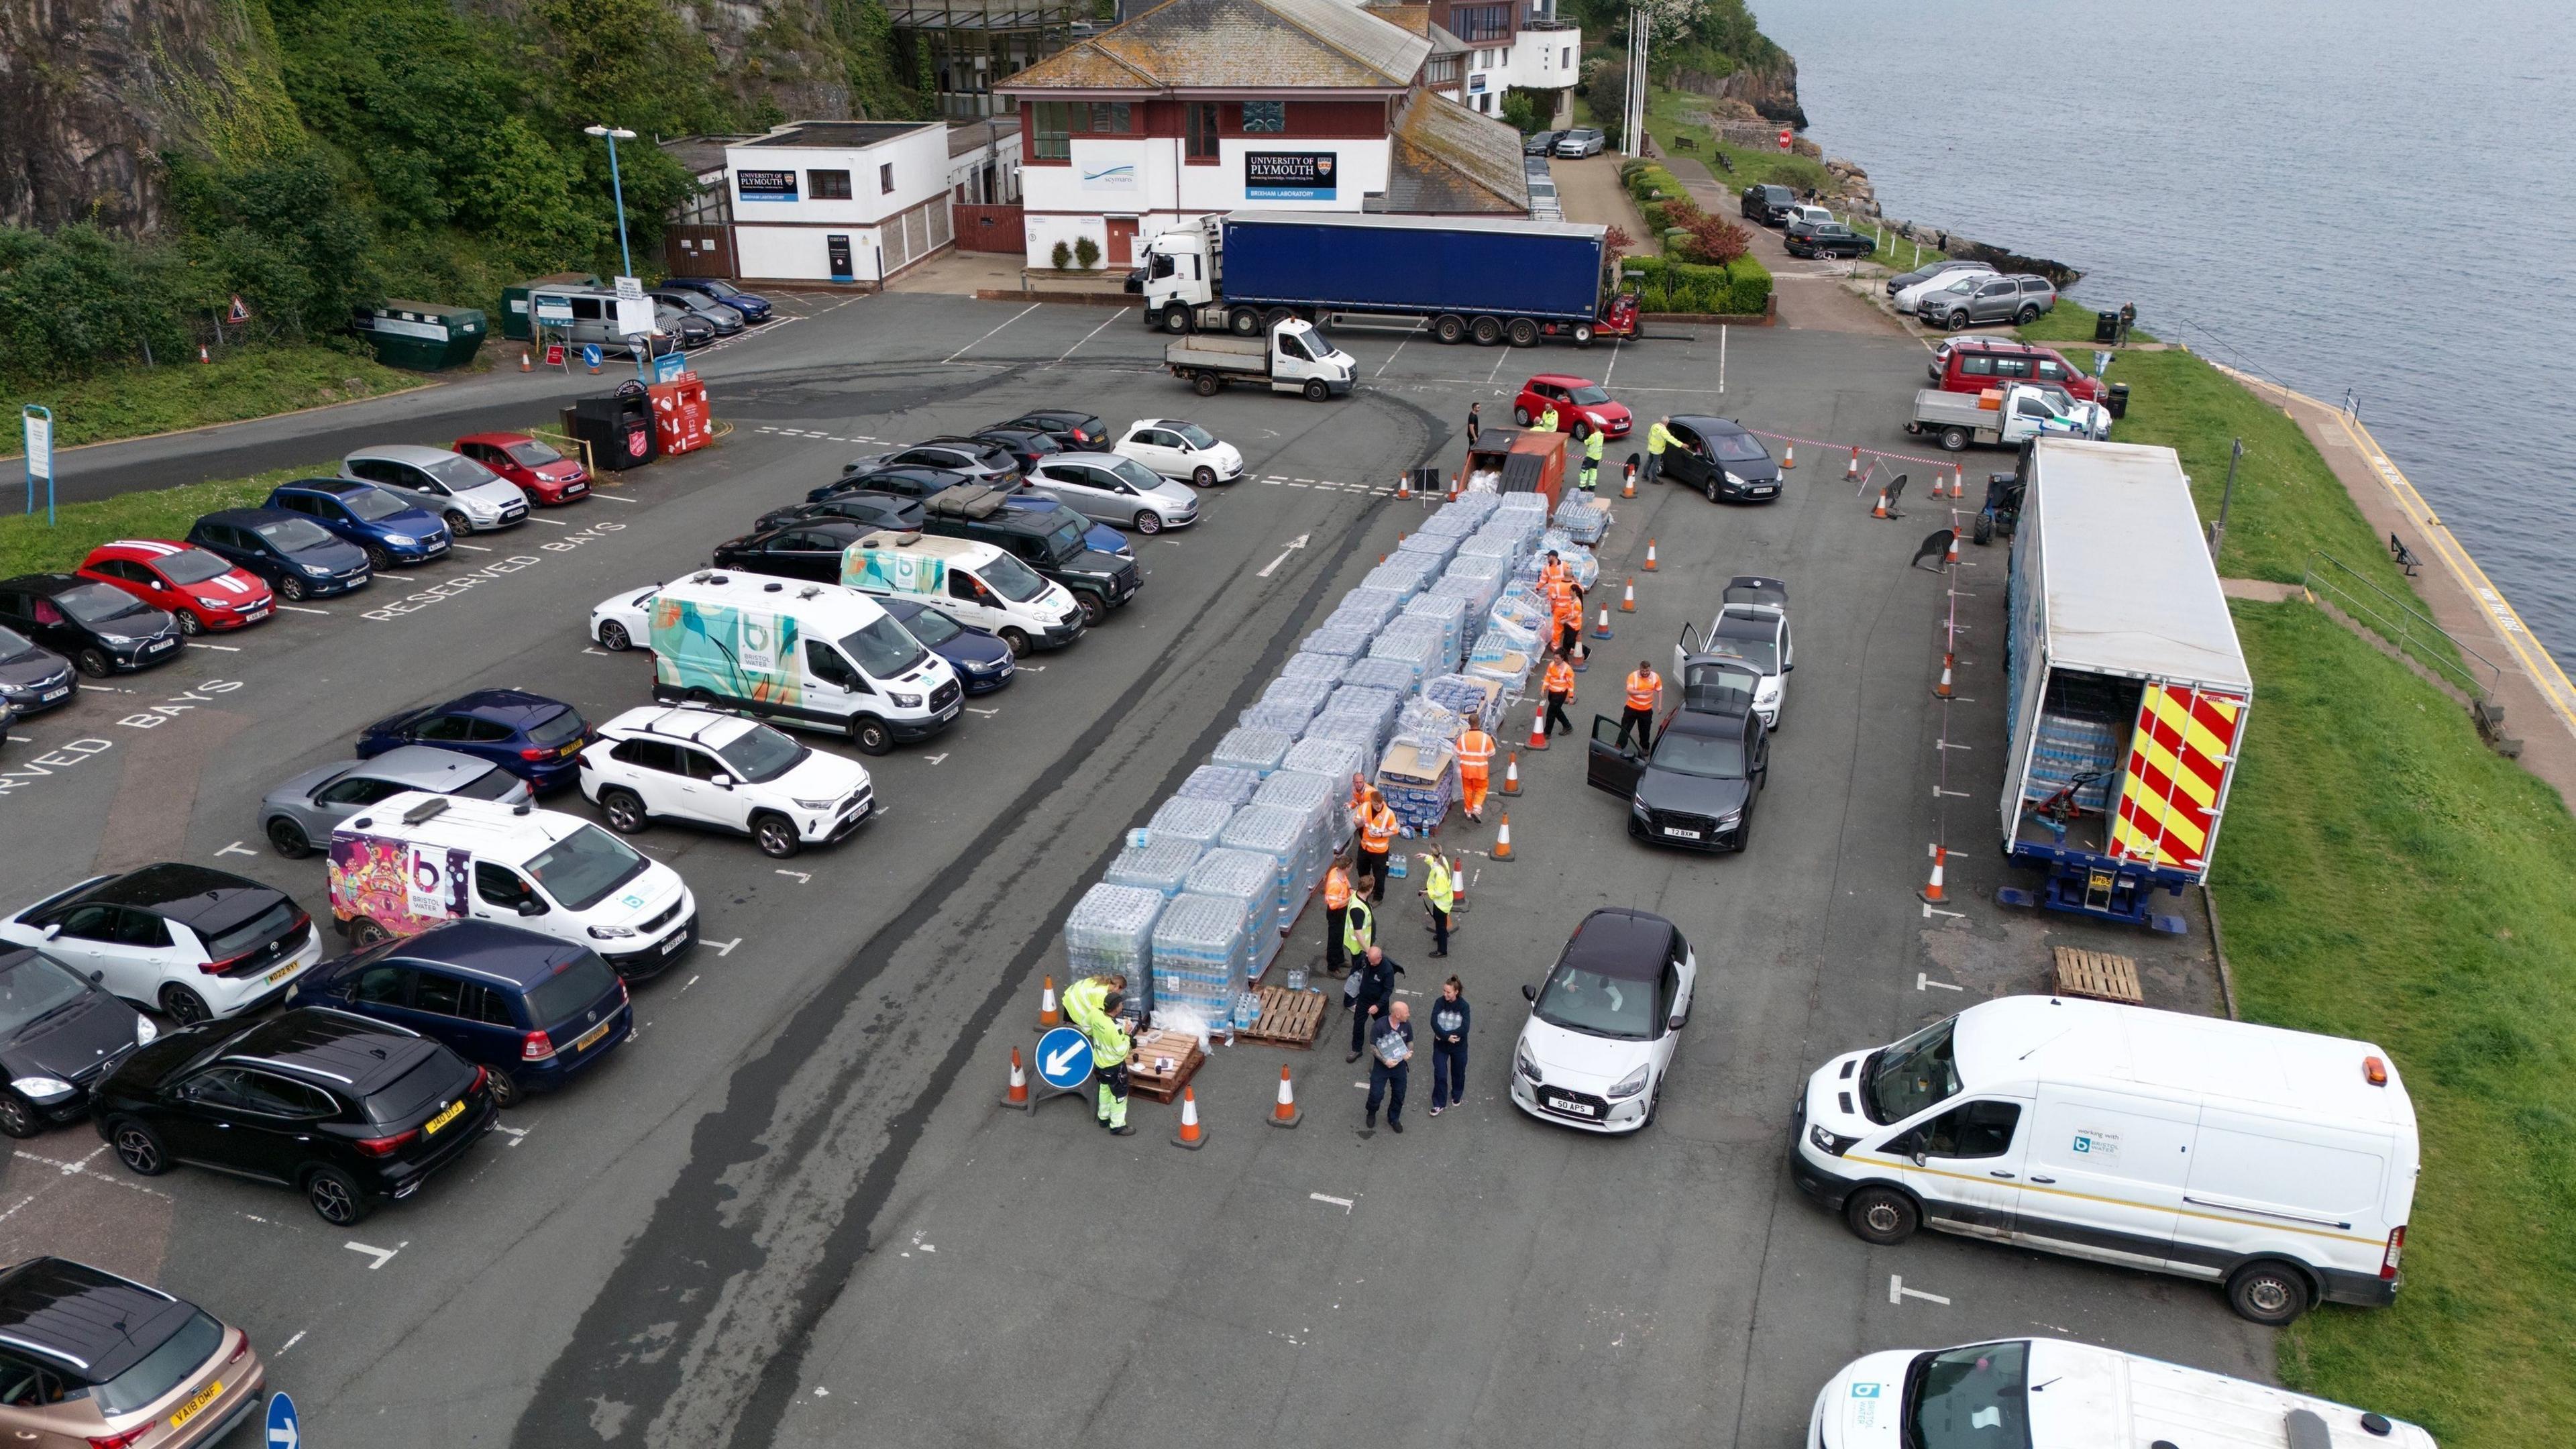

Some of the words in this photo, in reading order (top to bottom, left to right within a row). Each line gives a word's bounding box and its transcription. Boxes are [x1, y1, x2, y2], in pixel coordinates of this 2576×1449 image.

[1250, 156, 1301, 165] UNIVERSITY
[1303, 157, 1314, 165] OF
[1250, 164, 1314, 175] PLYMOUTH
[741, 178, 783, 186] PLYMOUTH
[615, 382, 630, 396] CLOTHES
[360, 555, 541, 621] RESERVED
[541, 522, 627, 551] BAYS
[745, 653, 770, 663] BRISTOL
[116, 680, 244, 728] BAYS
[413, 896, 439, 906] BRISTOL
[415, 903, 437, 912] WATER
[1569, 1104, 1585, 1113] APS
[2077, 1128, 2103, 1138] working
[2092, 1140, 2118, 1150] BRISTOL
[175, 1402, 198, 1421] VA18
[1857, 1401, 1866, 1424] WATER
[1866, 1400, 1876, 1429] BRISTOL
